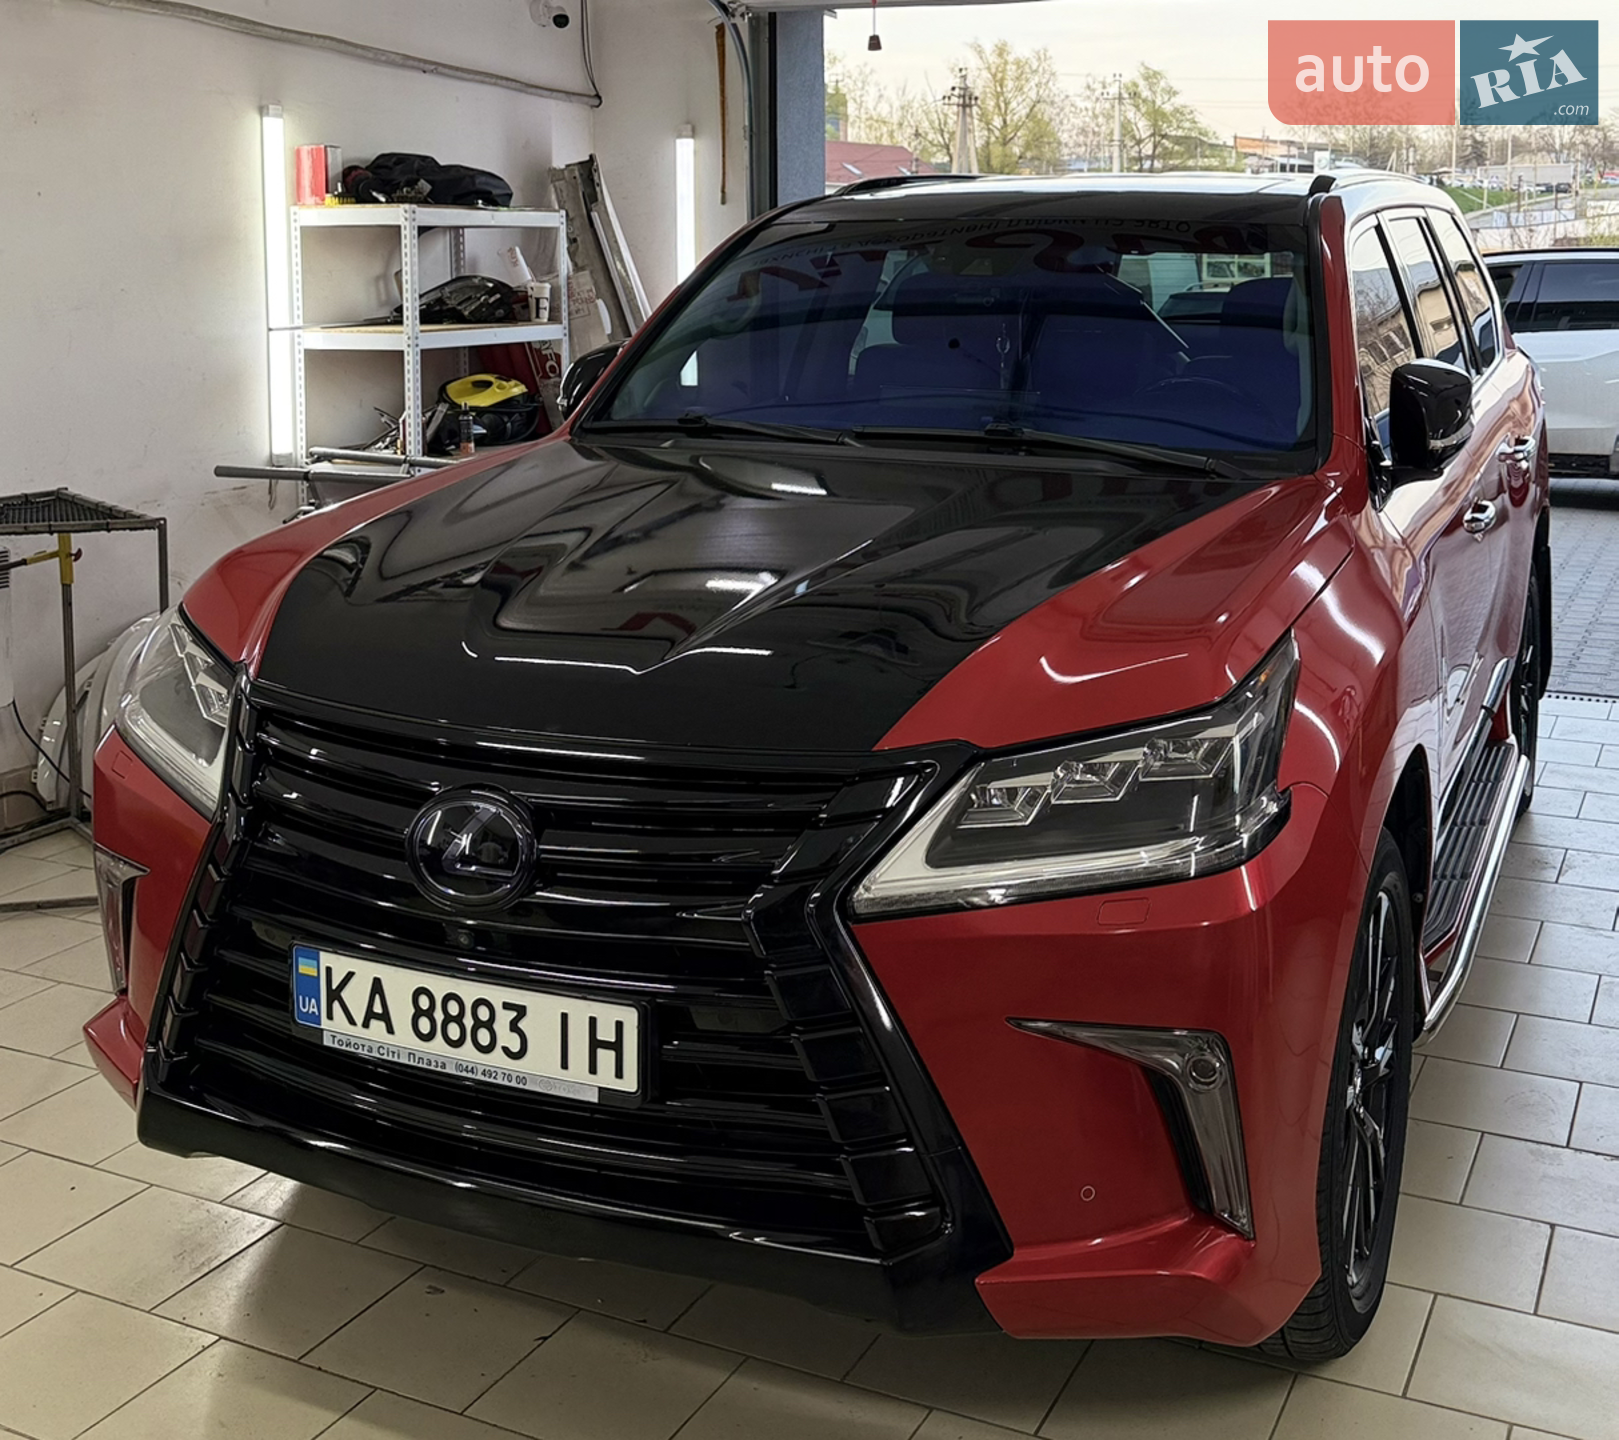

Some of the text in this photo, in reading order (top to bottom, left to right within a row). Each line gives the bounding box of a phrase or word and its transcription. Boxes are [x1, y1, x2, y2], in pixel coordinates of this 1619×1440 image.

[299, 995, 319, 1016] UA
[325, 965, 624, 1080] KA 8883 IH
[330, 1034, 528, 1086] Тойота Сіті Плаза (044) 492 70 00
